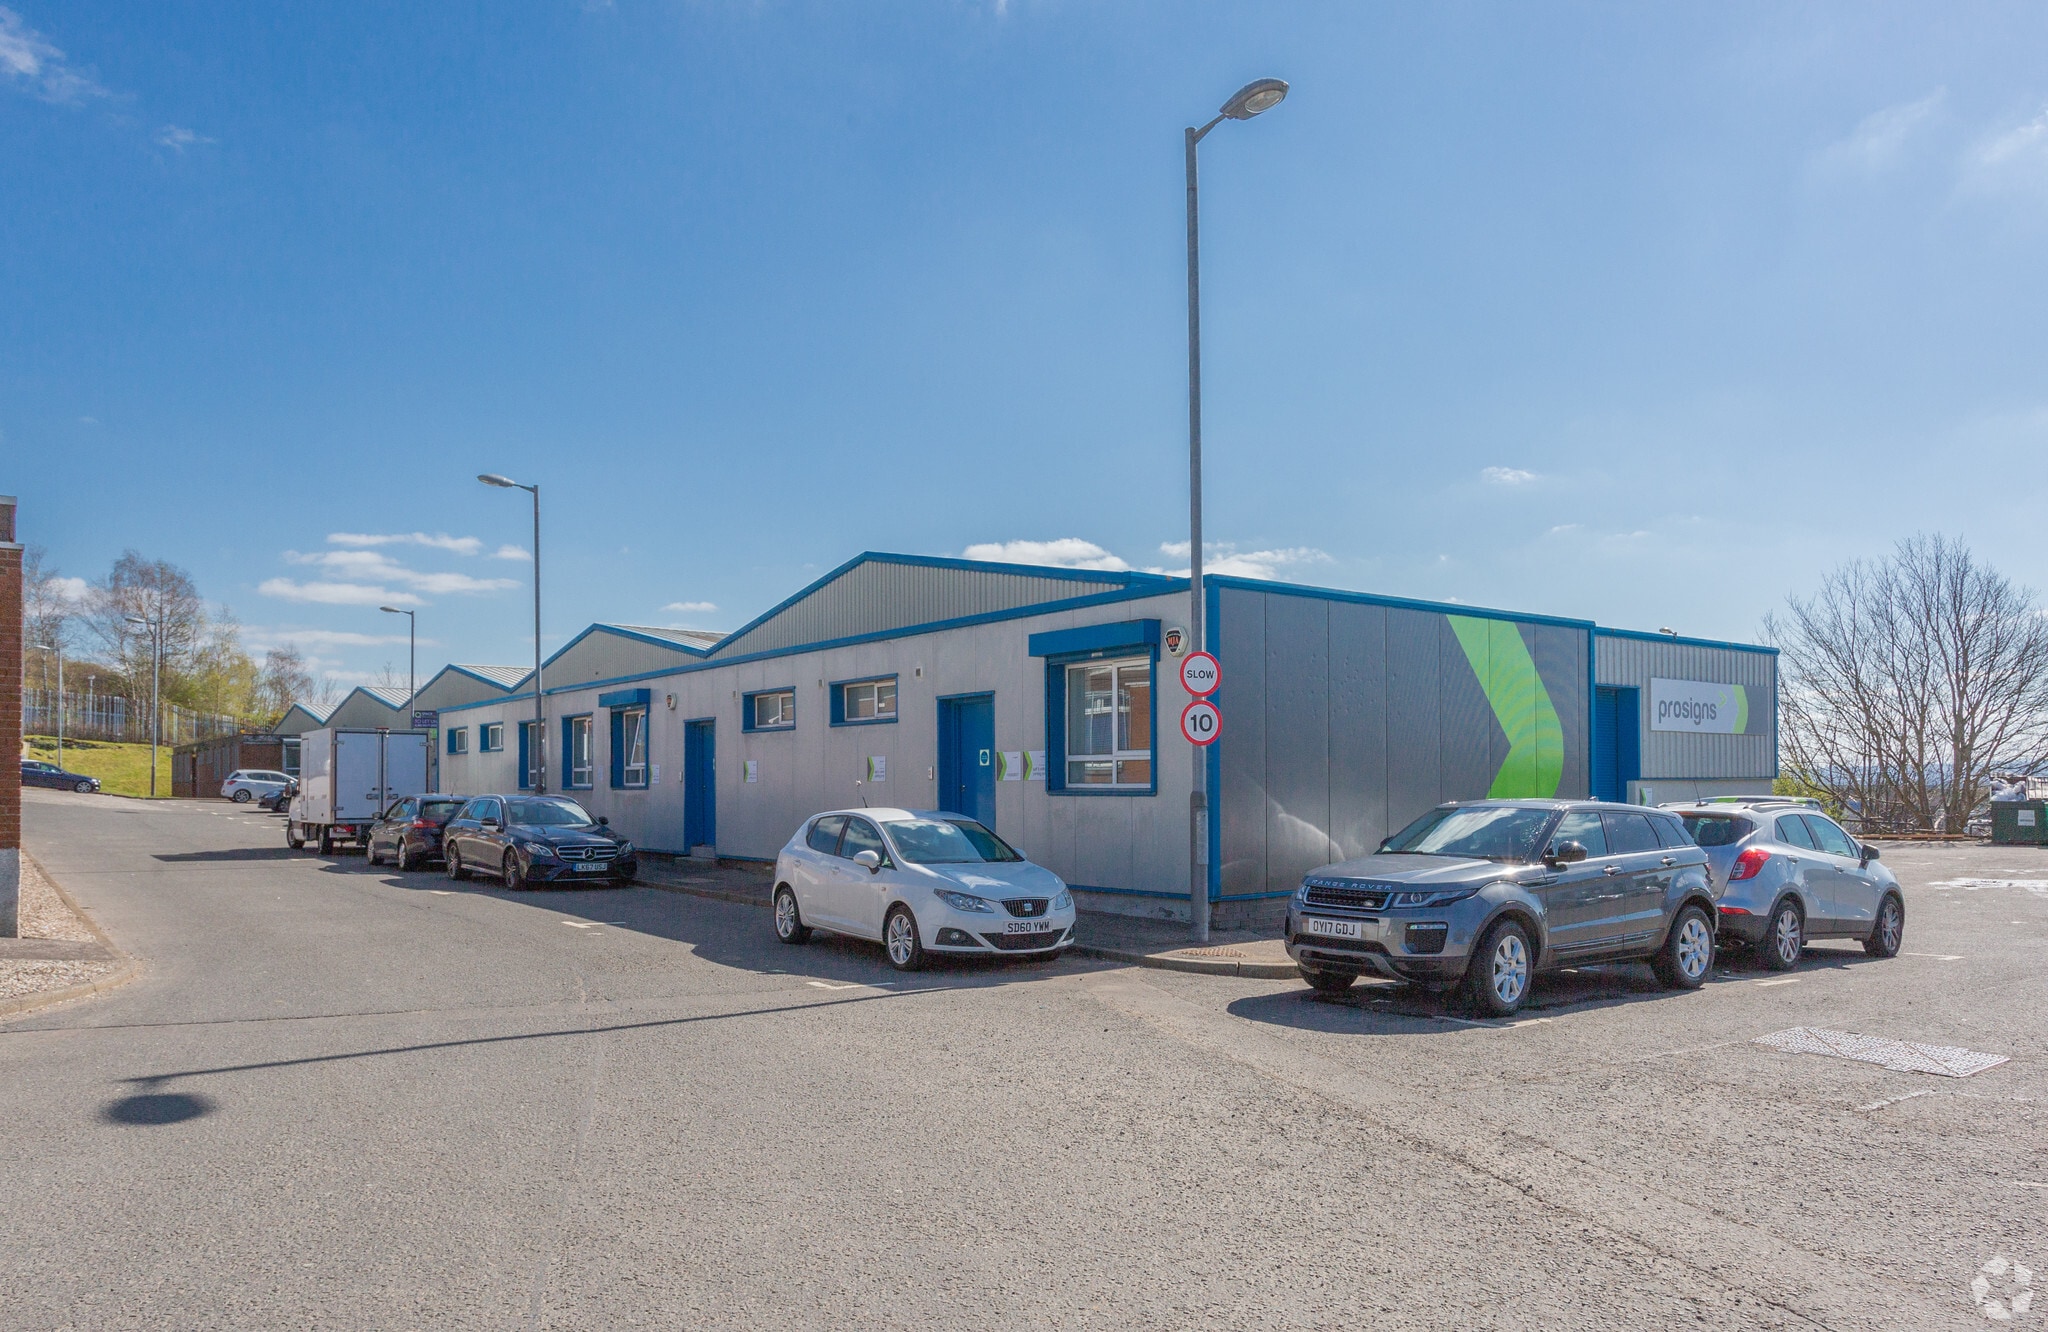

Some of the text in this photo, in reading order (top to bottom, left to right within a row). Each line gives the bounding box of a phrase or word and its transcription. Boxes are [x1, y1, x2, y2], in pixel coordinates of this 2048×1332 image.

[1186, 669, 1215, 679] SLOW
[1658, 697, 1717, 726] prosigns
[1190, 713, 1213, 733] 10
[1311, 879, 1392, 891] RANGE ROVER
[1007, 921, 1050, 933] SD60 YWM
[1313, 920, 1356, 936] OY17 GDJ
